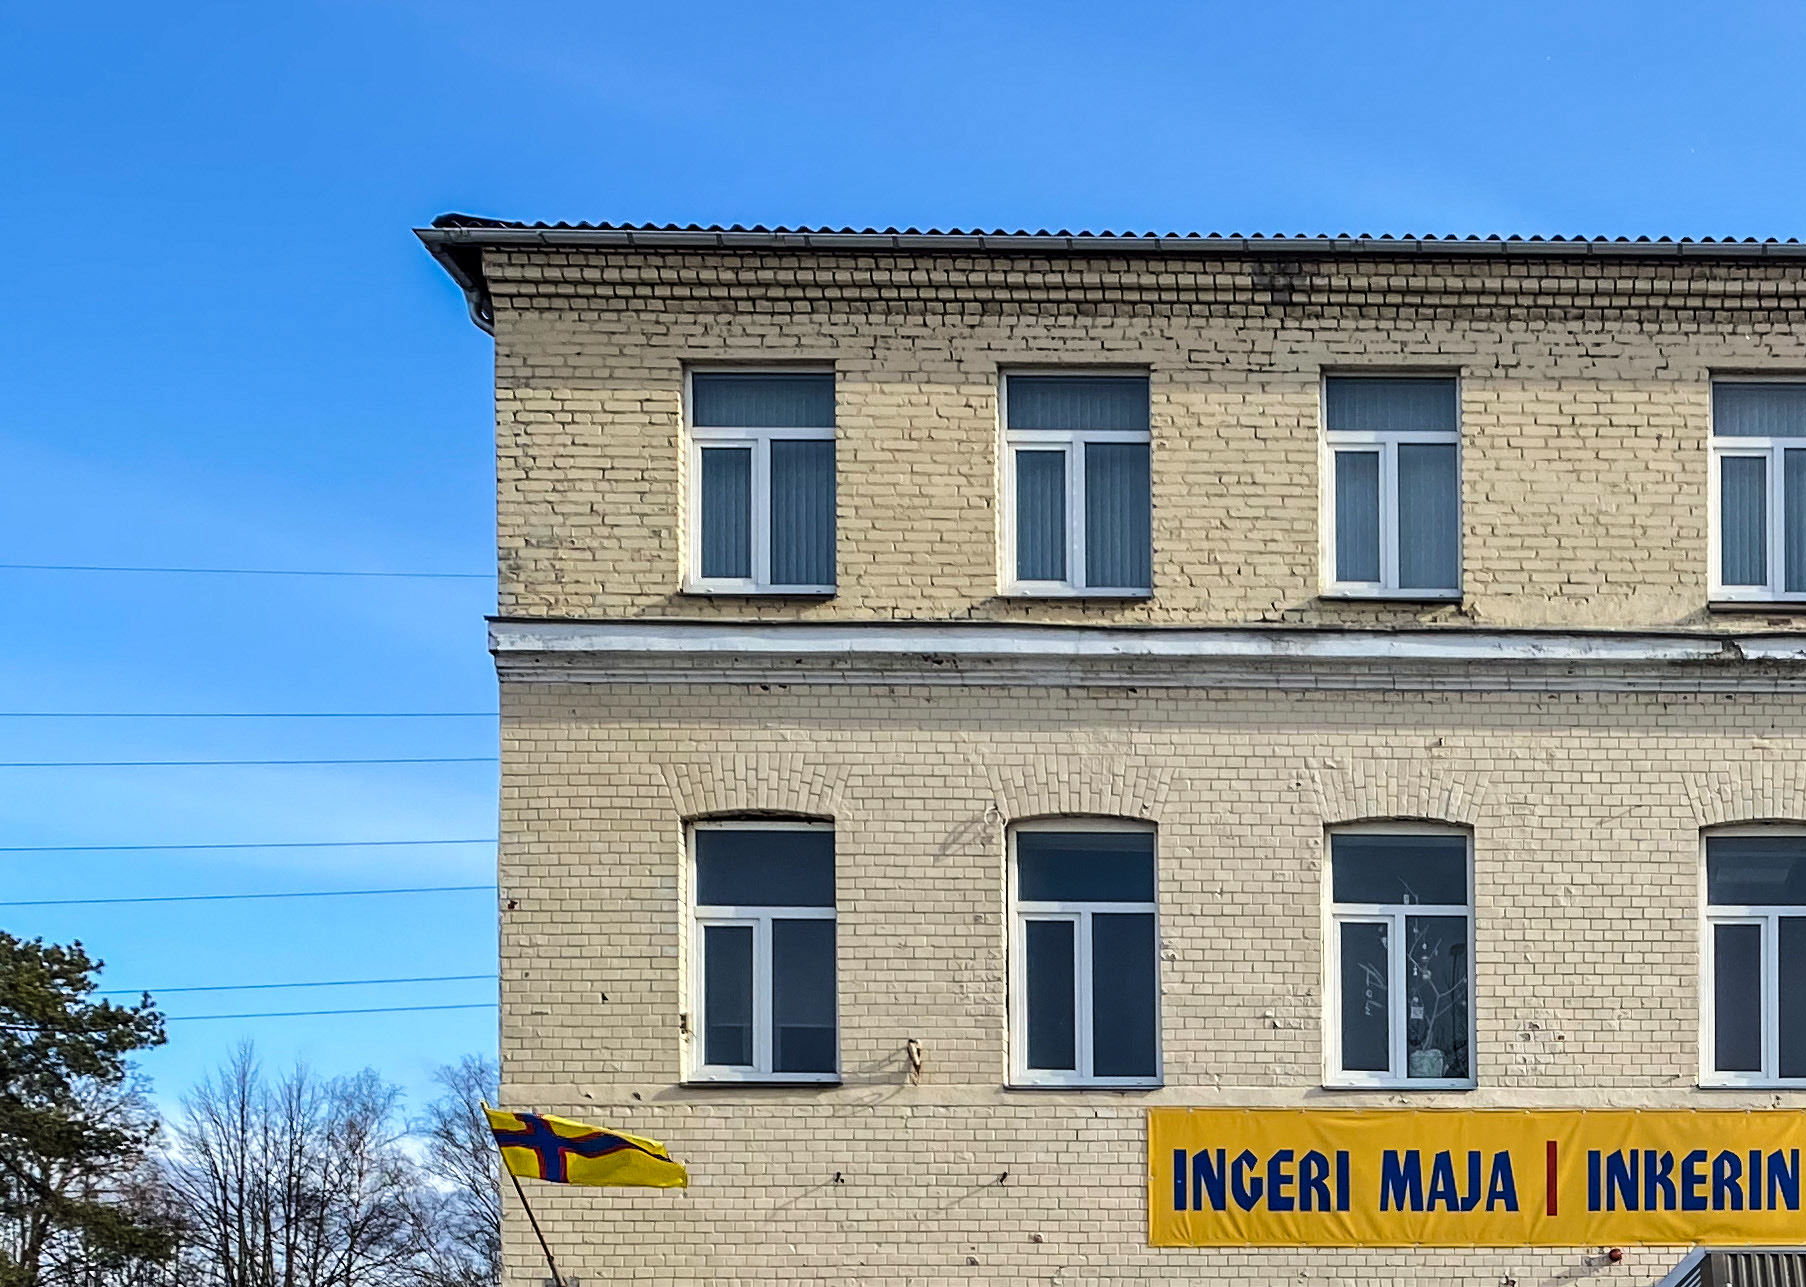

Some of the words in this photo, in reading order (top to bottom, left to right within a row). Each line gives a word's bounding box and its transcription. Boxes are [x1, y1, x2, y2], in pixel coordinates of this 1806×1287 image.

[1174, 1149, 1350, 1212] INGERI
[1380, 1149, 1519, 1212] MAJA
[1588, 1148, 1800, 1211] INKERIN
